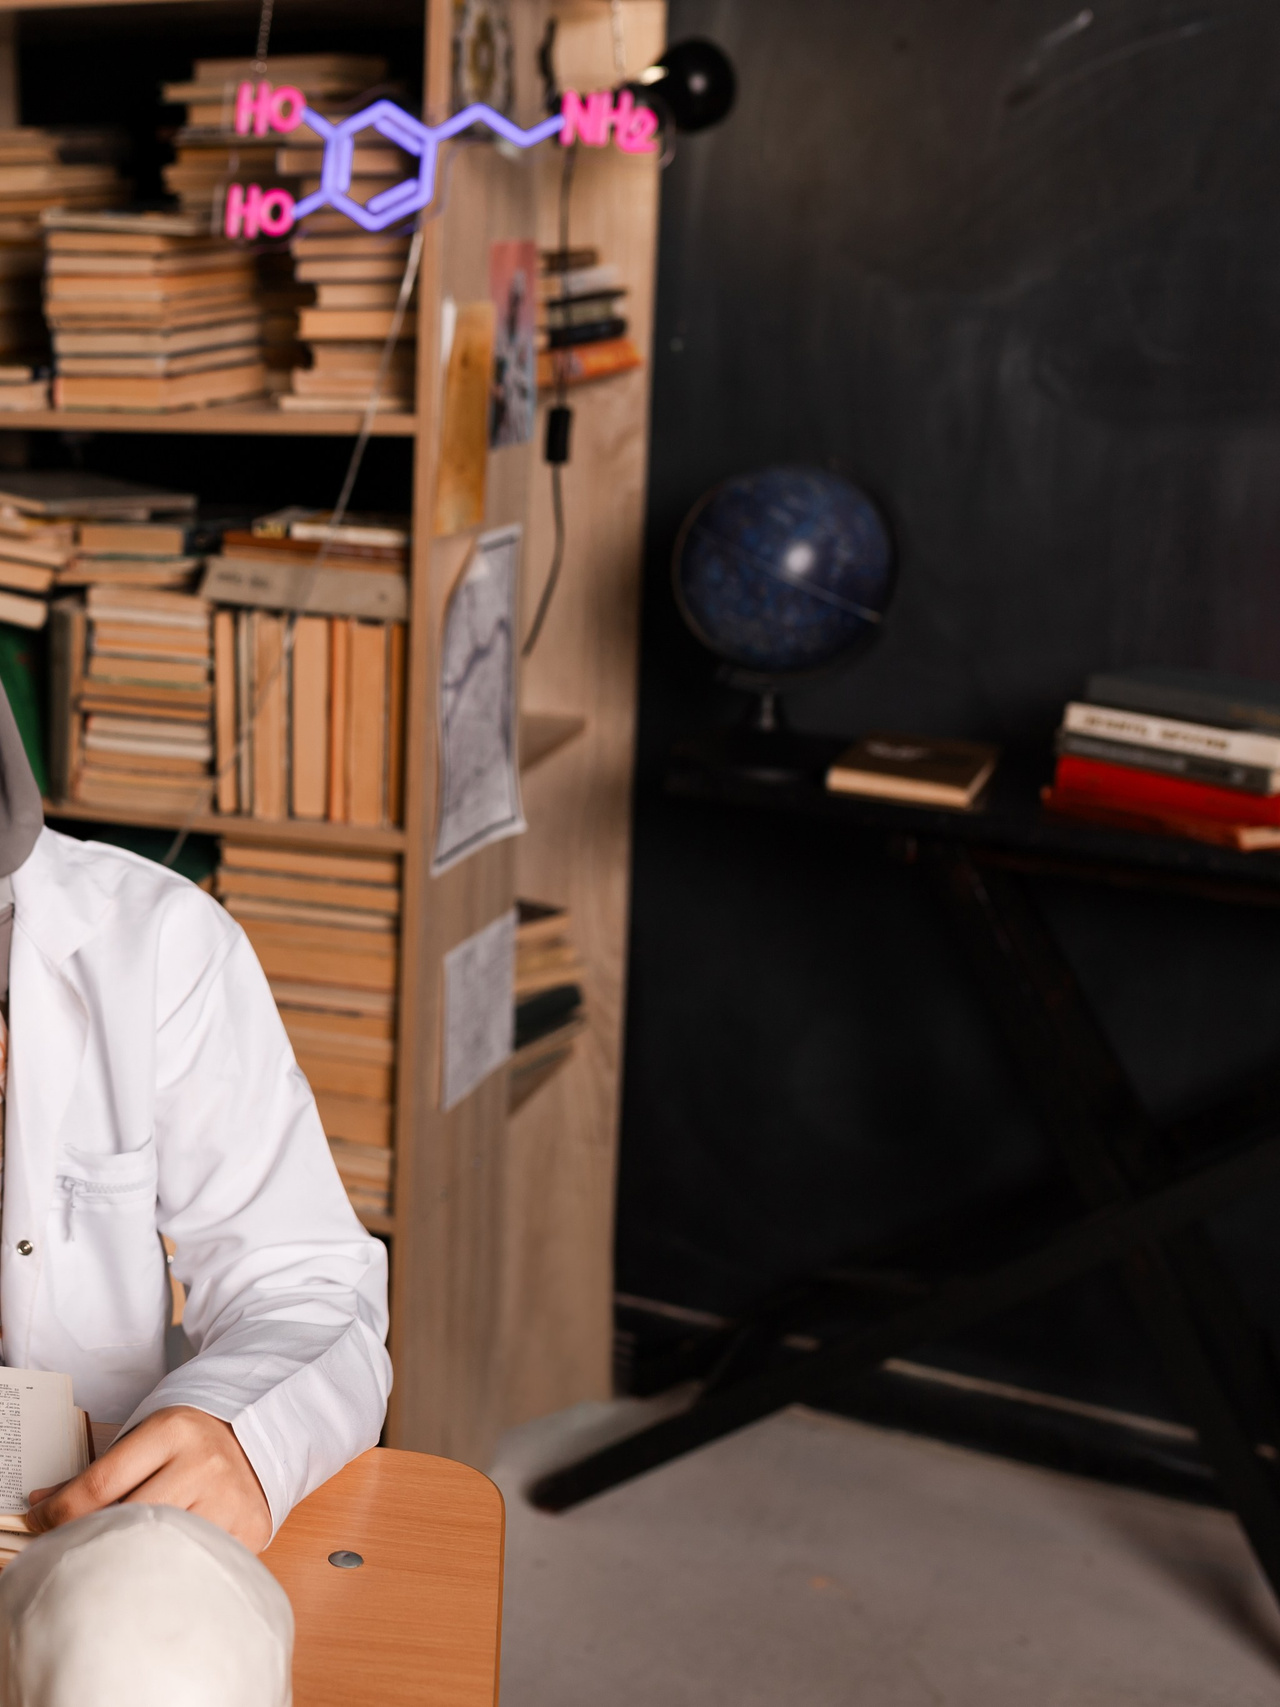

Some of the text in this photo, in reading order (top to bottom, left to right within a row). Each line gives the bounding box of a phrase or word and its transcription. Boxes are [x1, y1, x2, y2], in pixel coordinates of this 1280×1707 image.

[234, 79, 307, 137] HO
[559, 89, 659, 155] NH2
[224, 182, 297, 239] HO
